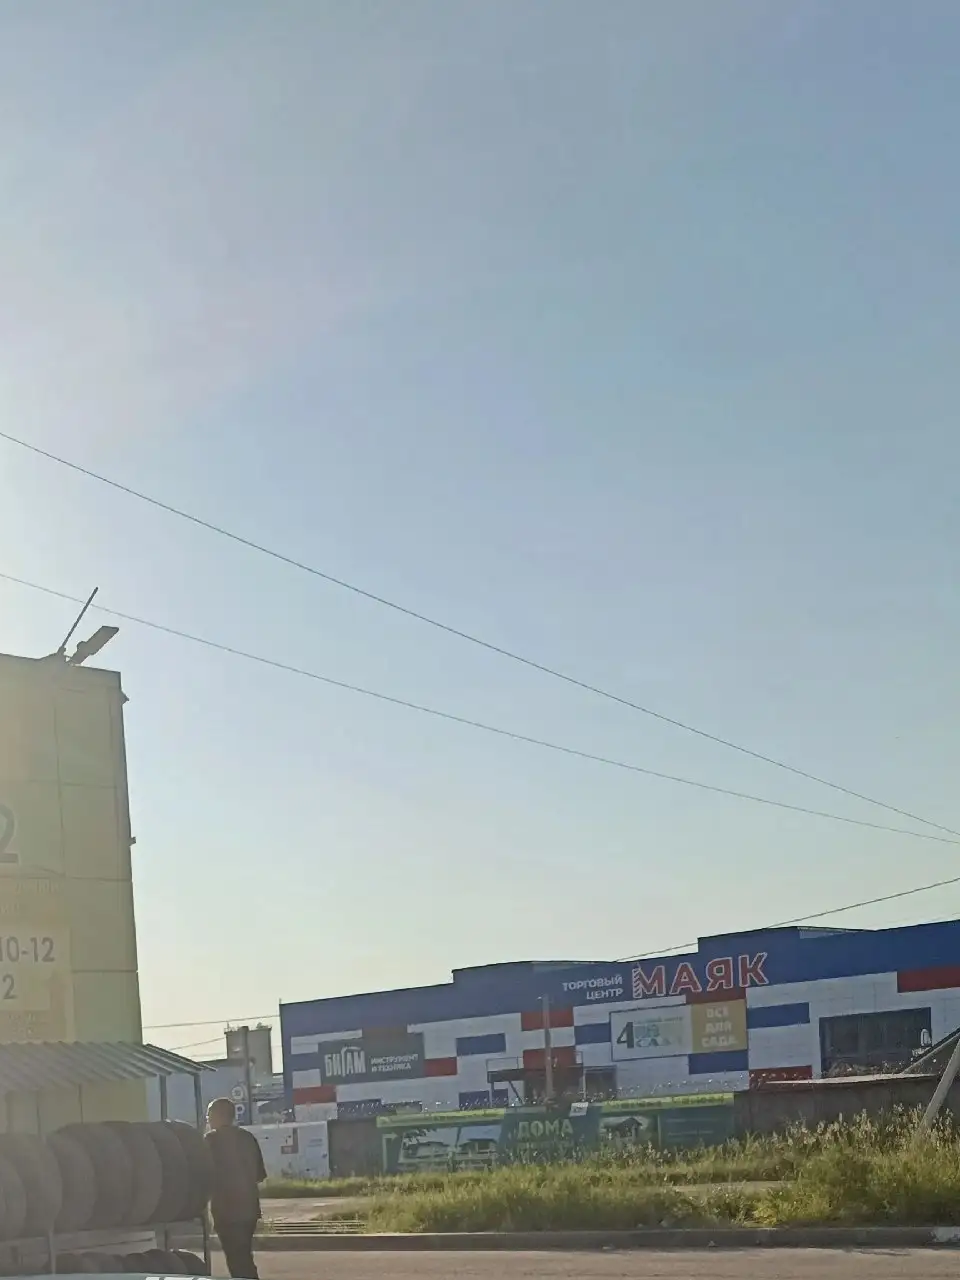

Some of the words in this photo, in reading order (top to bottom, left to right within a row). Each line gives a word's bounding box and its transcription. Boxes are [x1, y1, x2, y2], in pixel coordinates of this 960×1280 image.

[562, 974, 623, 991] ТОРГОВЫЙ
[631, 952, 769, 999] МАЯК
[586, 988, 624, 1001] ЦЕНТР
